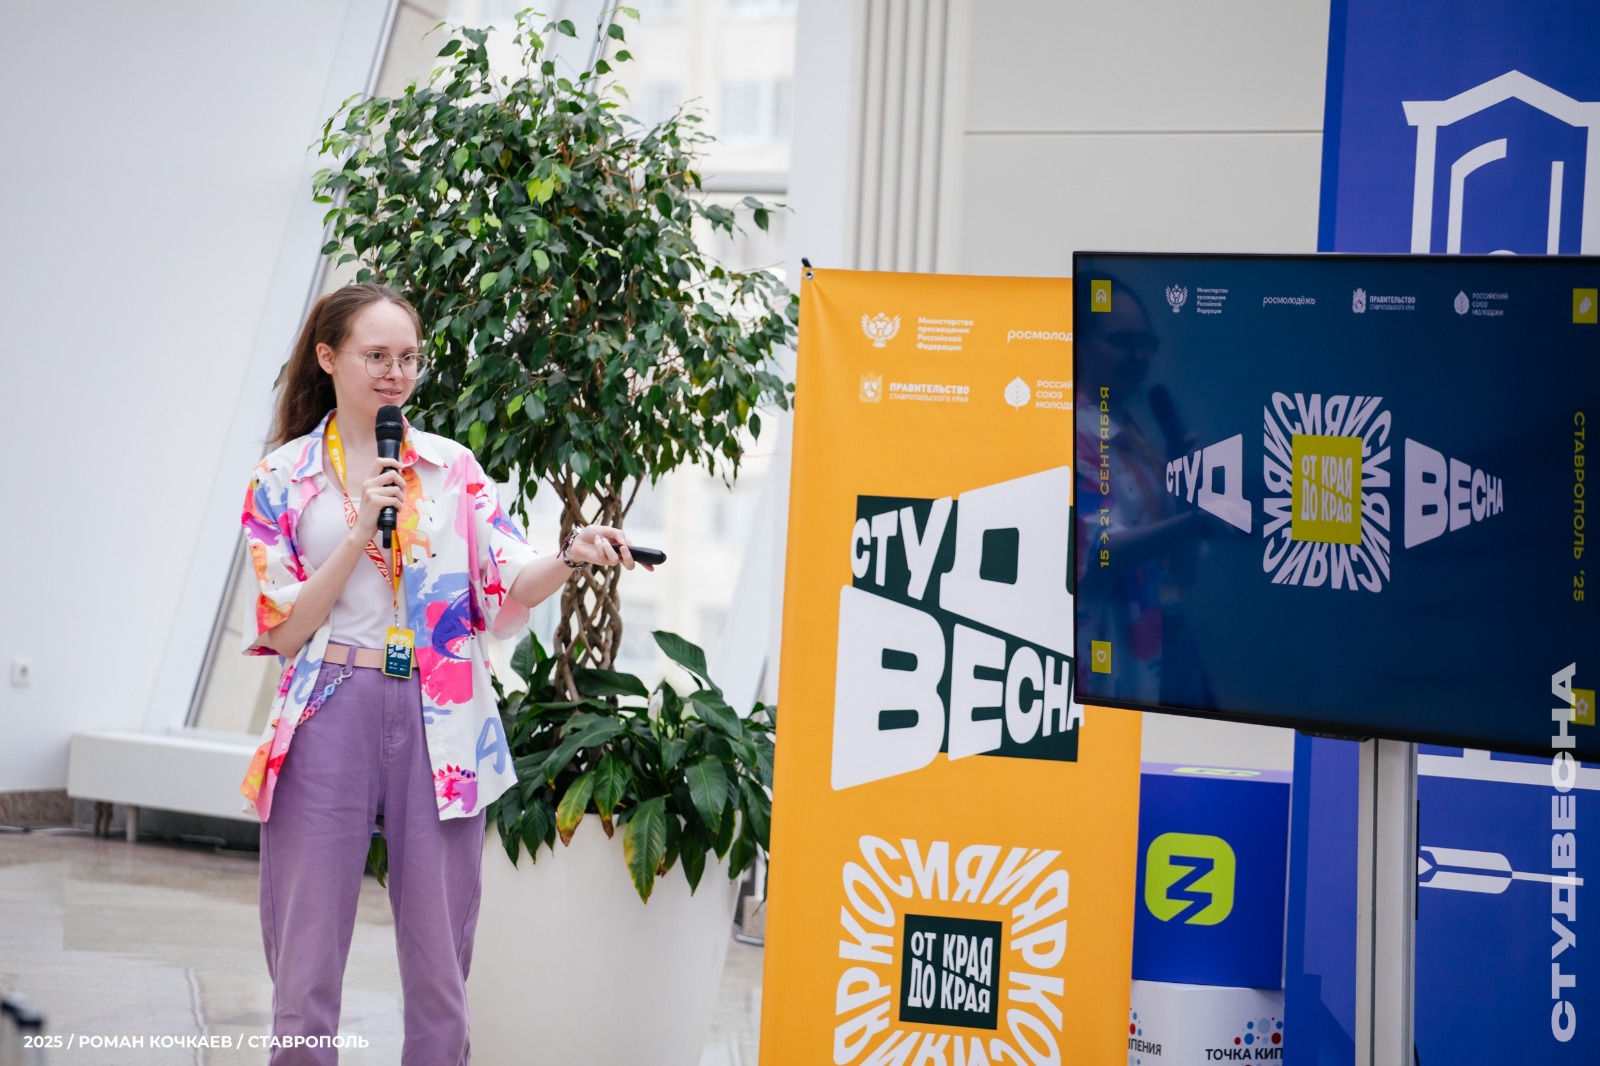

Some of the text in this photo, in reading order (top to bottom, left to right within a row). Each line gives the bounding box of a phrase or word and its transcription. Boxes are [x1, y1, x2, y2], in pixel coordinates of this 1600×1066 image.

[1369, 296, 1416, 304] ПРАВИТЕЛЬСТВО
[889, 383, 970, 395] ПРАВИТЕЛЬСТВО
[1036, 390, 1063, 399] СОЮЗ
[1100, 386, 1110, 567] 15 21 СЕНТЯБРЯ
[1165, 433, 1252, 534] СТУД
[1301, 455, 1353, 499] ОТ КРАЯ
[1301, 478, 1353, 524] ДО КРАЯ
[1404, 437, 1504, 549] ВЕСНА
[1573, 411, 1585, 559] СТАВРОПОЛЬ
[850, 465, 1074, 658] СТУД
[907, 957, 991, 1013] ДО КРАЯ
[910, 931, 994, 987] ОТ КРАЯ
[1205, 1047, 1283, 1061] ТОЧКА КИП
